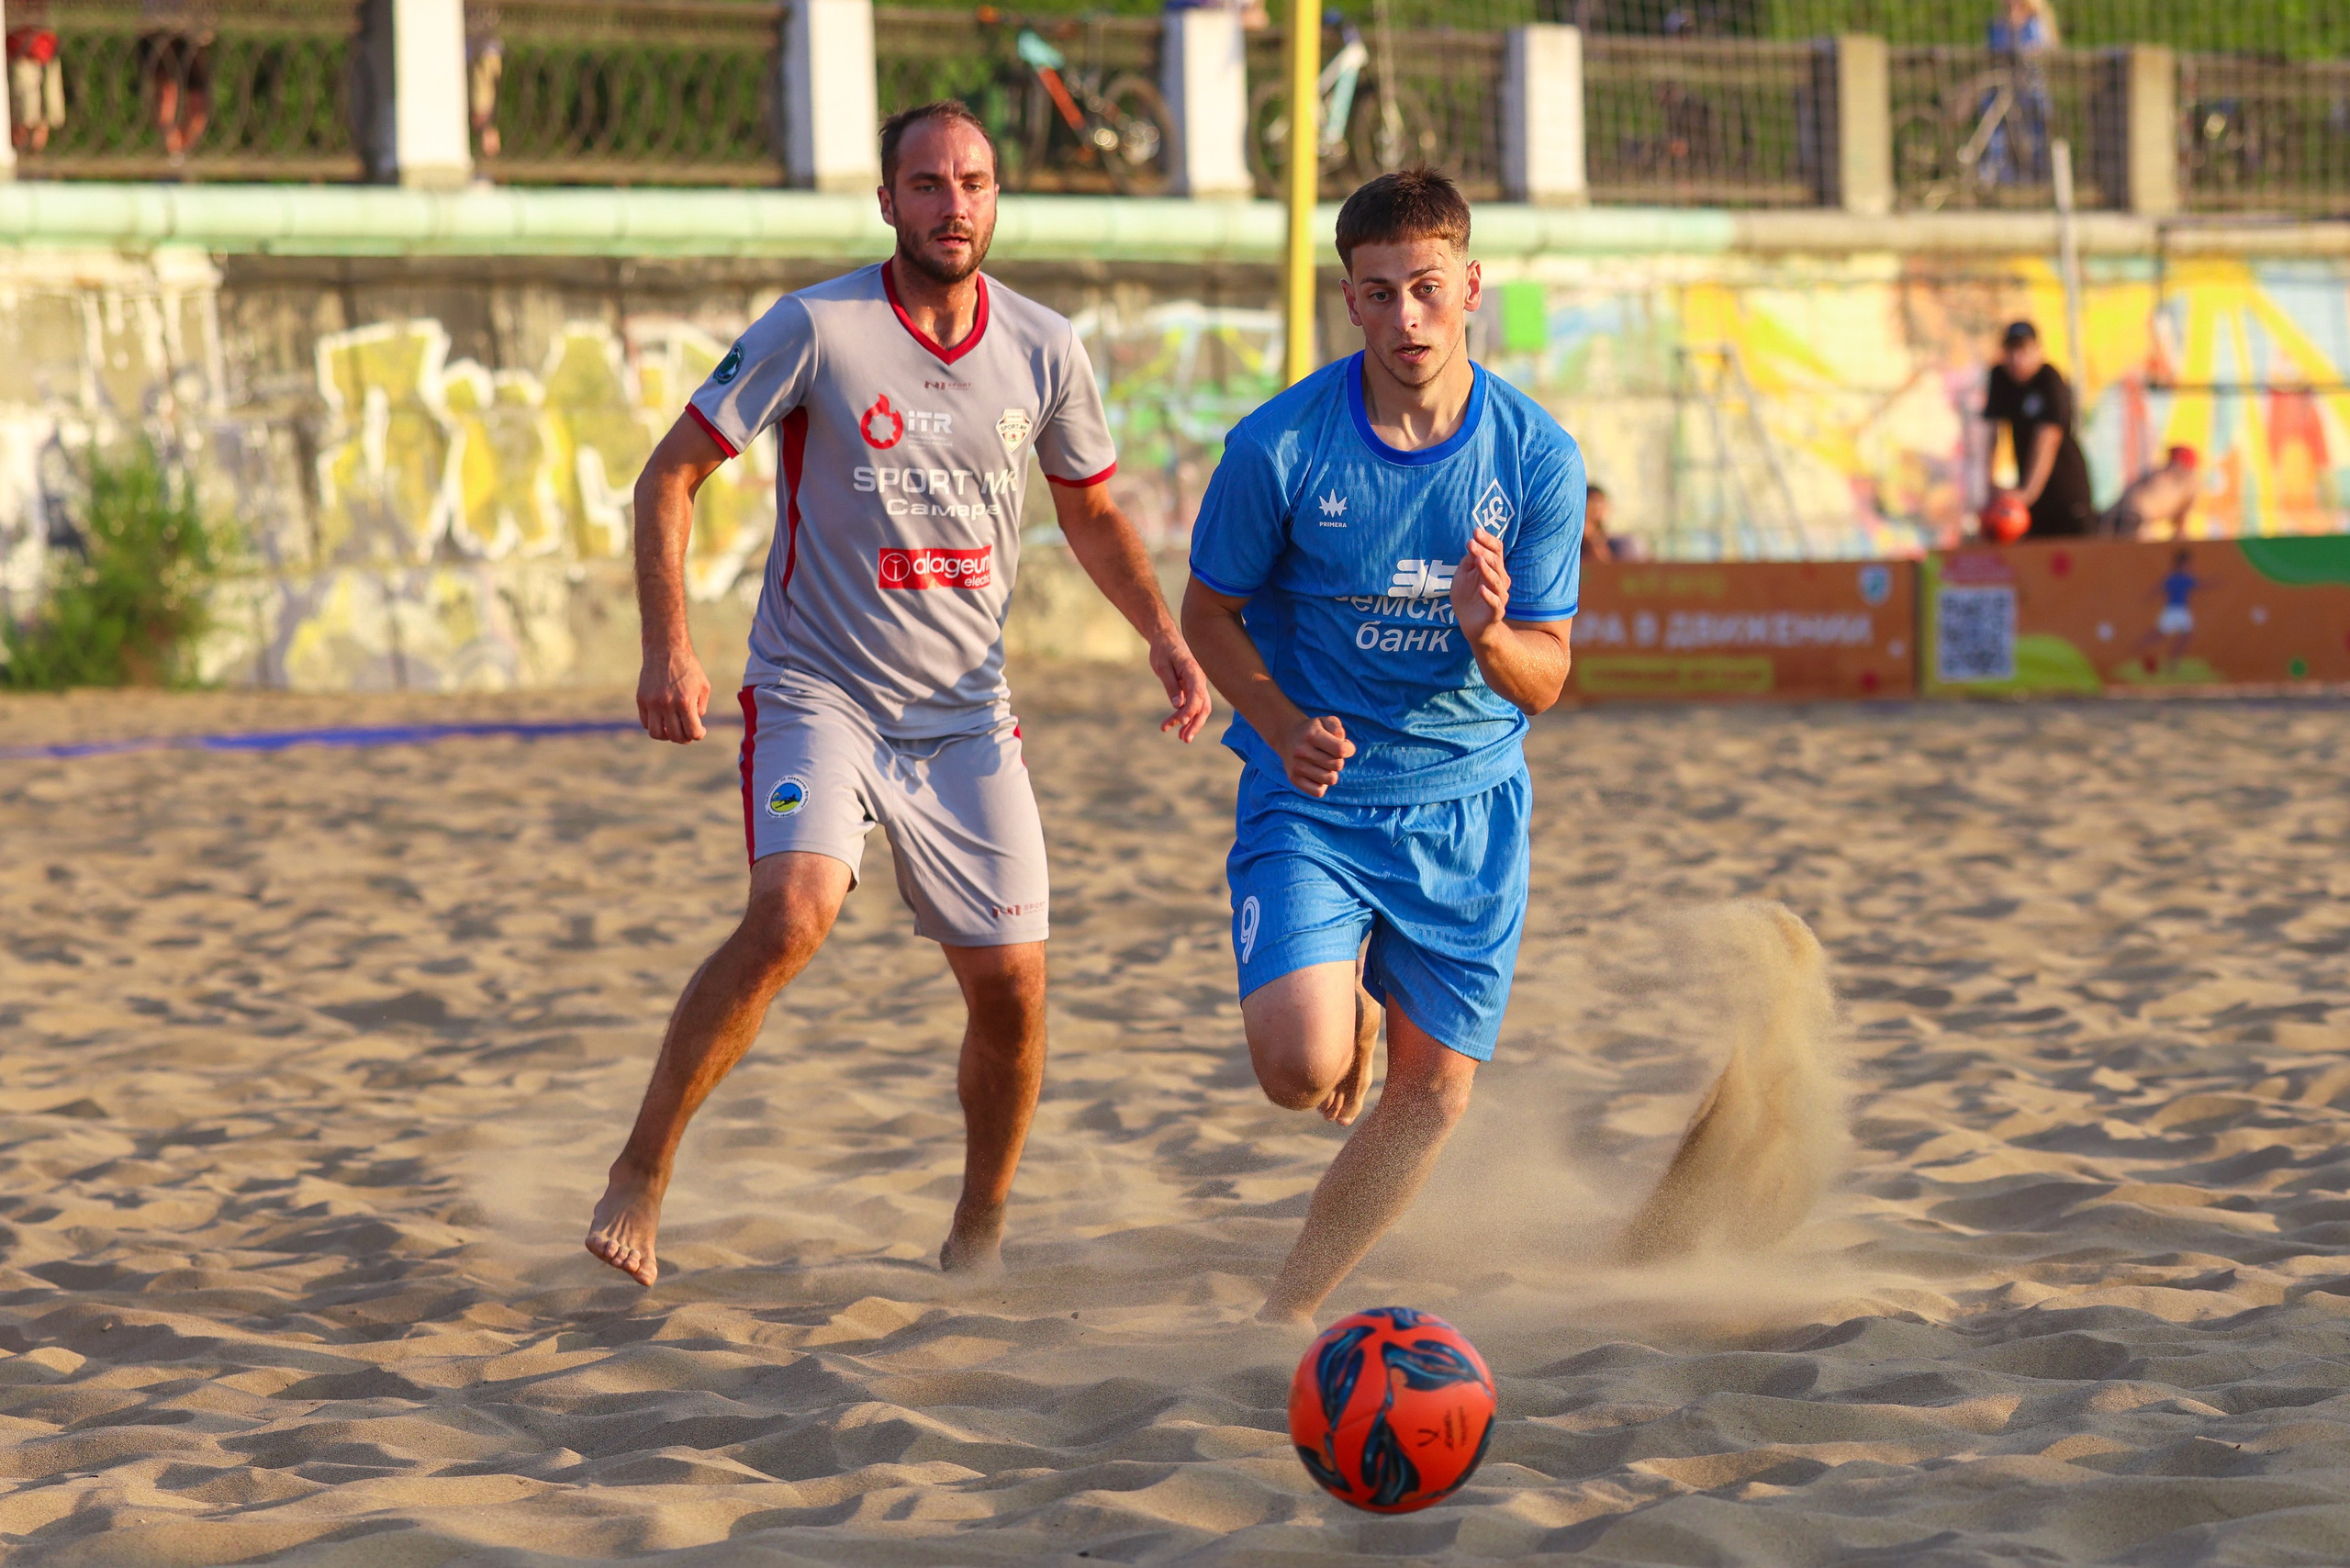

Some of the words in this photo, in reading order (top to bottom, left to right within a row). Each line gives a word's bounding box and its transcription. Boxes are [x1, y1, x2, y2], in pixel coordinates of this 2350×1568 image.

[853, 466, 973, 496] SPORT
[980, 466, 1020, 496] MK
[887, 498, 1001, 521] Самара
[1334, 595, 1456, 624] емск
[1356, 621, 1452, 653] банк
[1662, 612, 1873, 651] ДВИЖЕНИИ
[1240, 895, 1260, 964] 9
